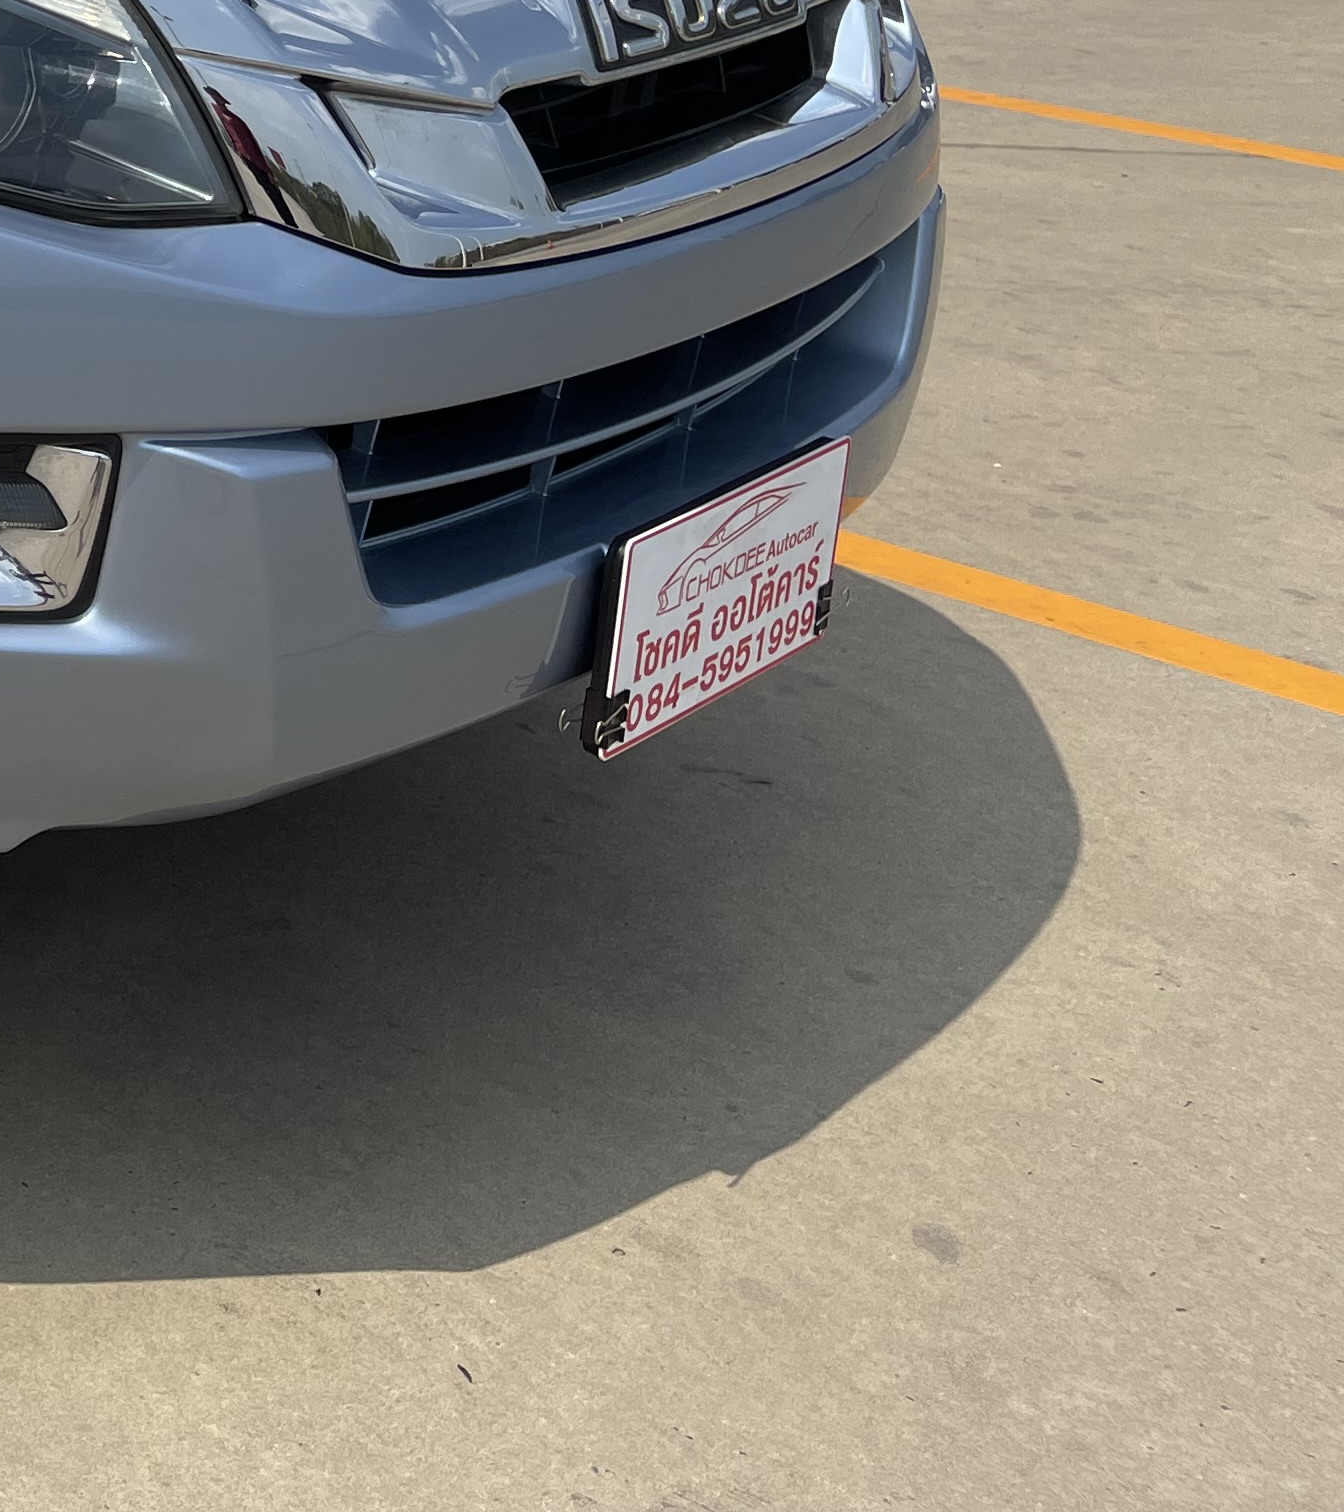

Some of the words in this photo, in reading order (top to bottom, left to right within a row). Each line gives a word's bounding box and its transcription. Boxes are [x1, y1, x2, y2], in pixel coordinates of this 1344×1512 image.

[632, 601, 705, 684] โชคดี
[710, 538, 825, 642] ออโต้คาร์
[685, 541, 767, 602] CHOKDEE
[765, 520, 819, 562] Autocar
[625, 599, 816, 733] 084-5951999
